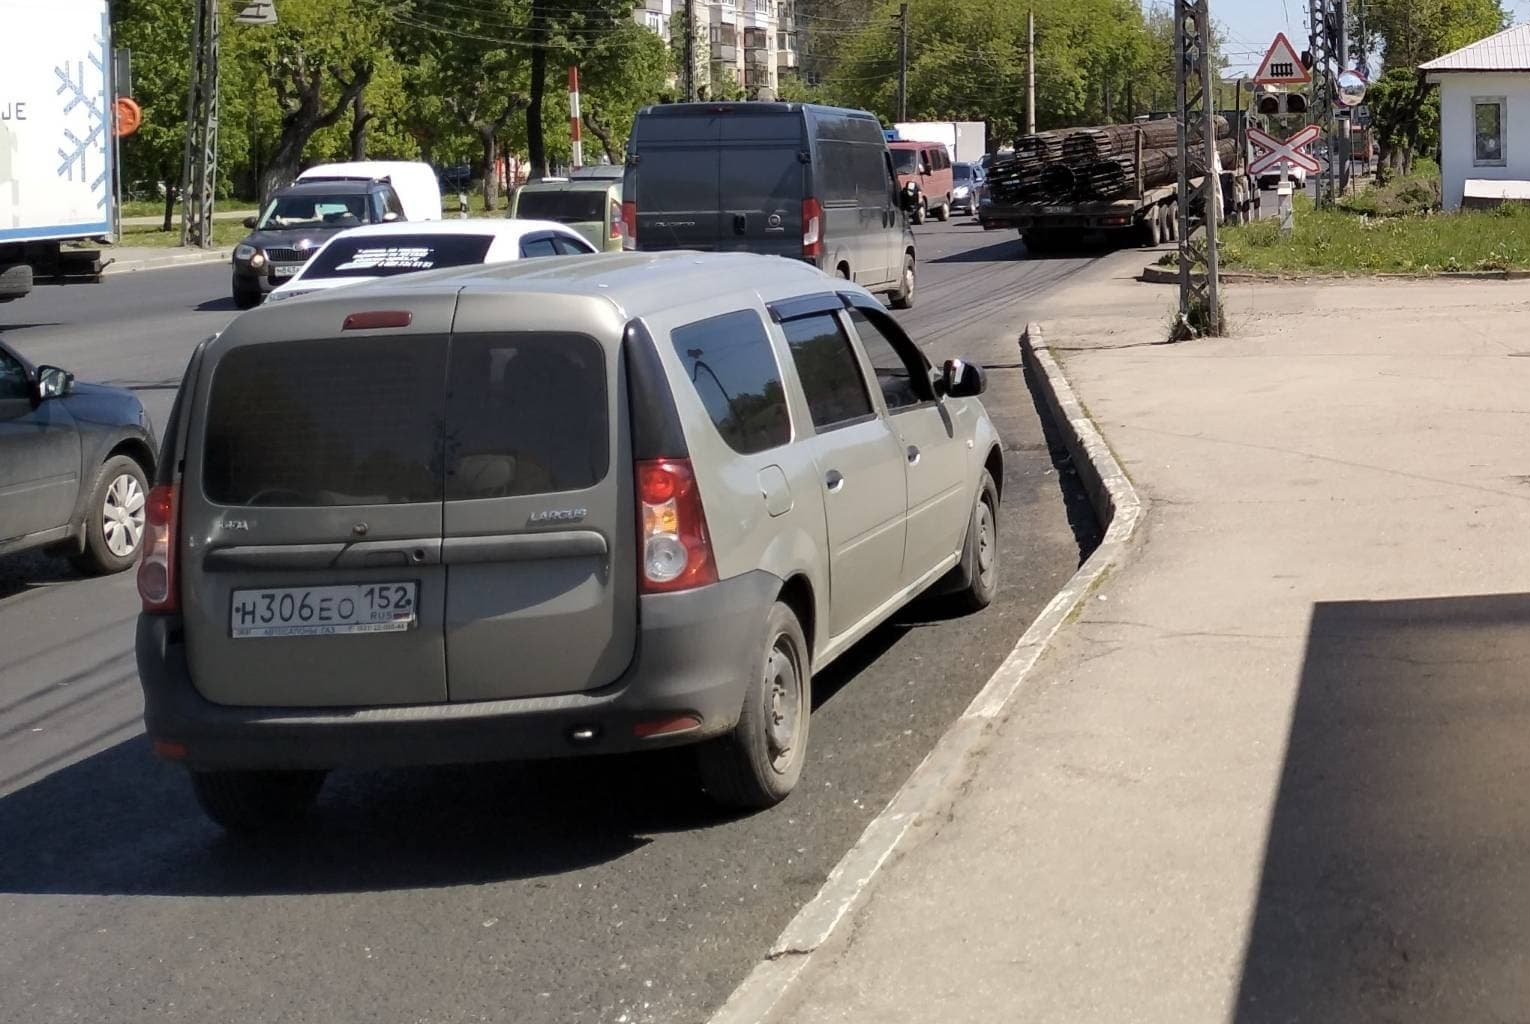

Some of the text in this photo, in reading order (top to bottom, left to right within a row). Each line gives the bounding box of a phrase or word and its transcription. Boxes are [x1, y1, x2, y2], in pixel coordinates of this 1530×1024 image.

[241, 586, 408, 625] Н306ЕО 152
[369, 610, 393, 621] RUS
